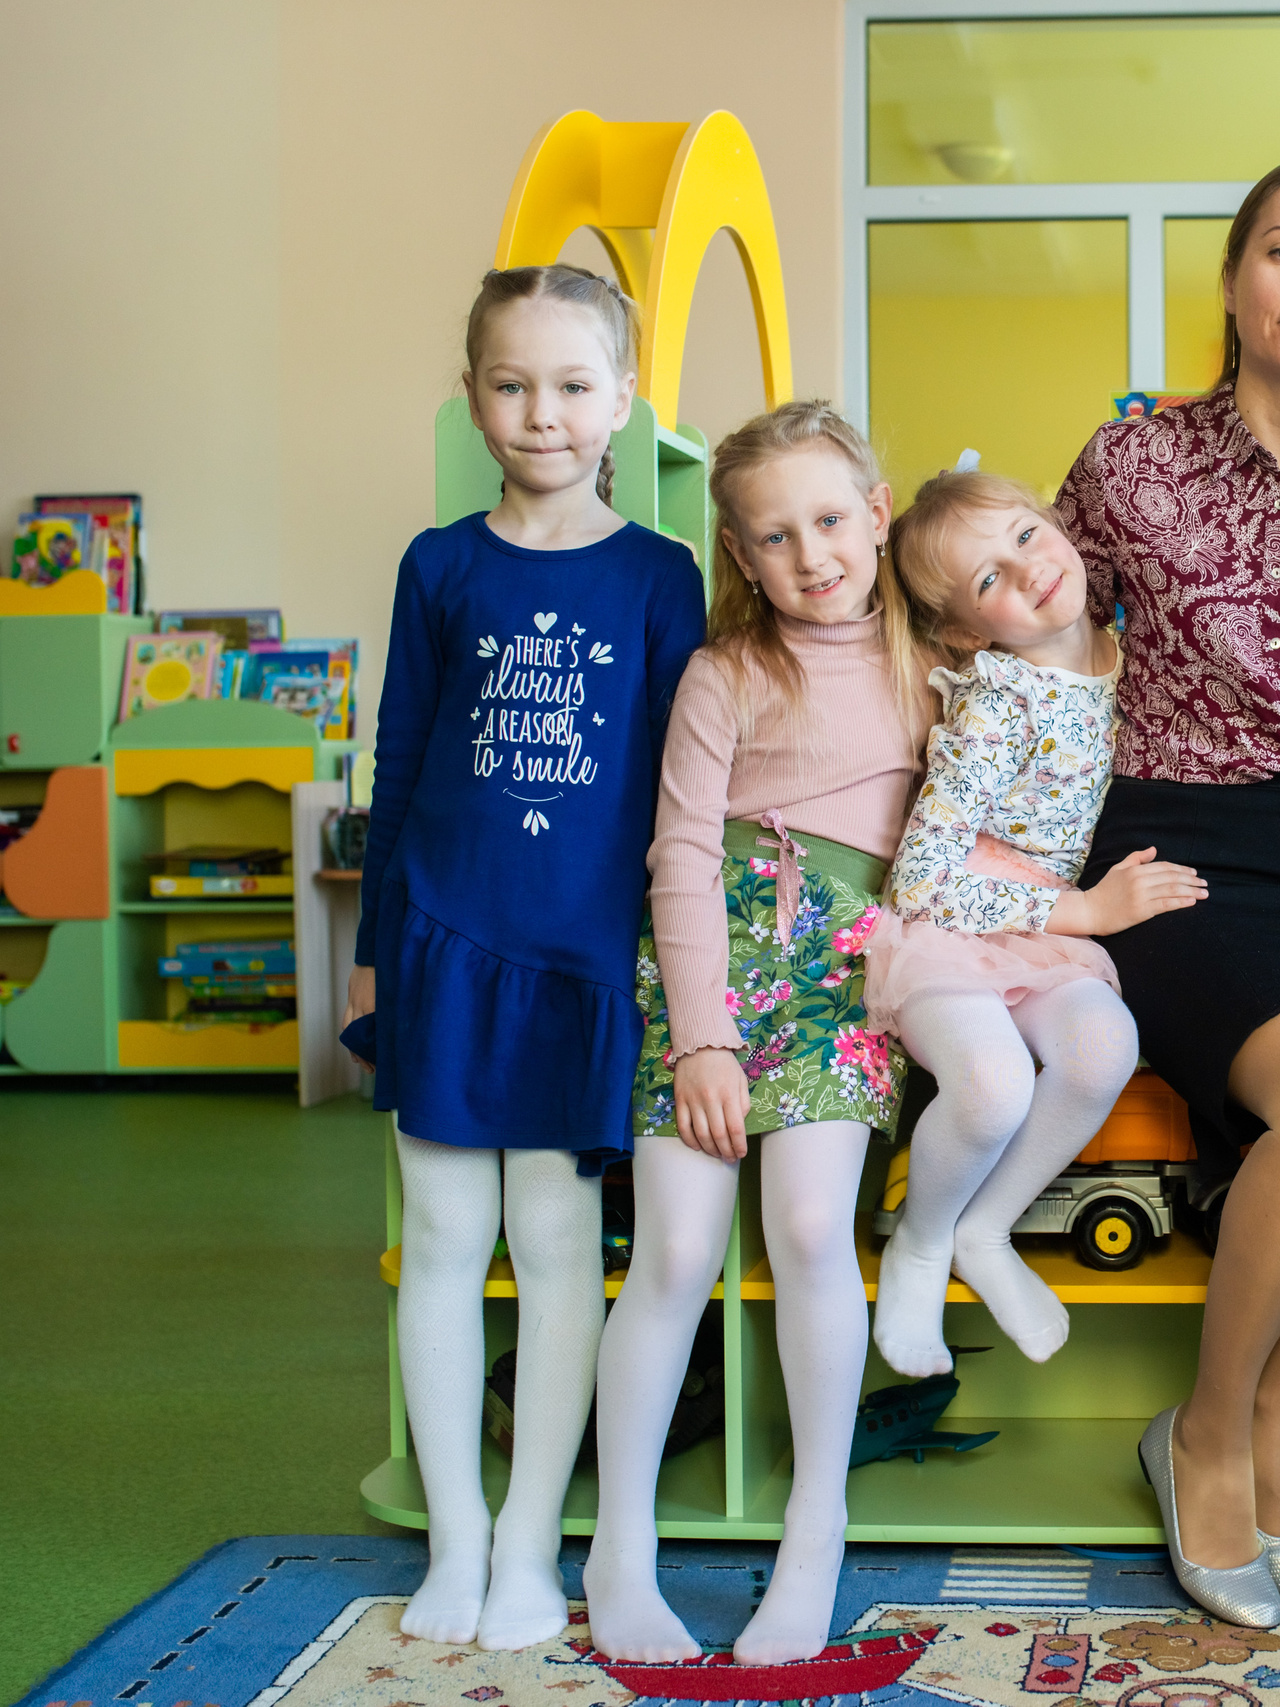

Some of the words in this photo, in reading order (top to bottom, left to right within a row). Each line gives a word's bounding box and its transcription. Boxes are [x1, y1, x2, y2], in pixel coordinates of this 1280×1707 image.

[514, 635, 579, 668] THERE'S
[481, 644, 585, 734] always
[483, 708, 495, 739] A
[499, 708, 574, 746] REASON
[472, 733, 503, 777] to
[512, 733, 598, 785] smile
